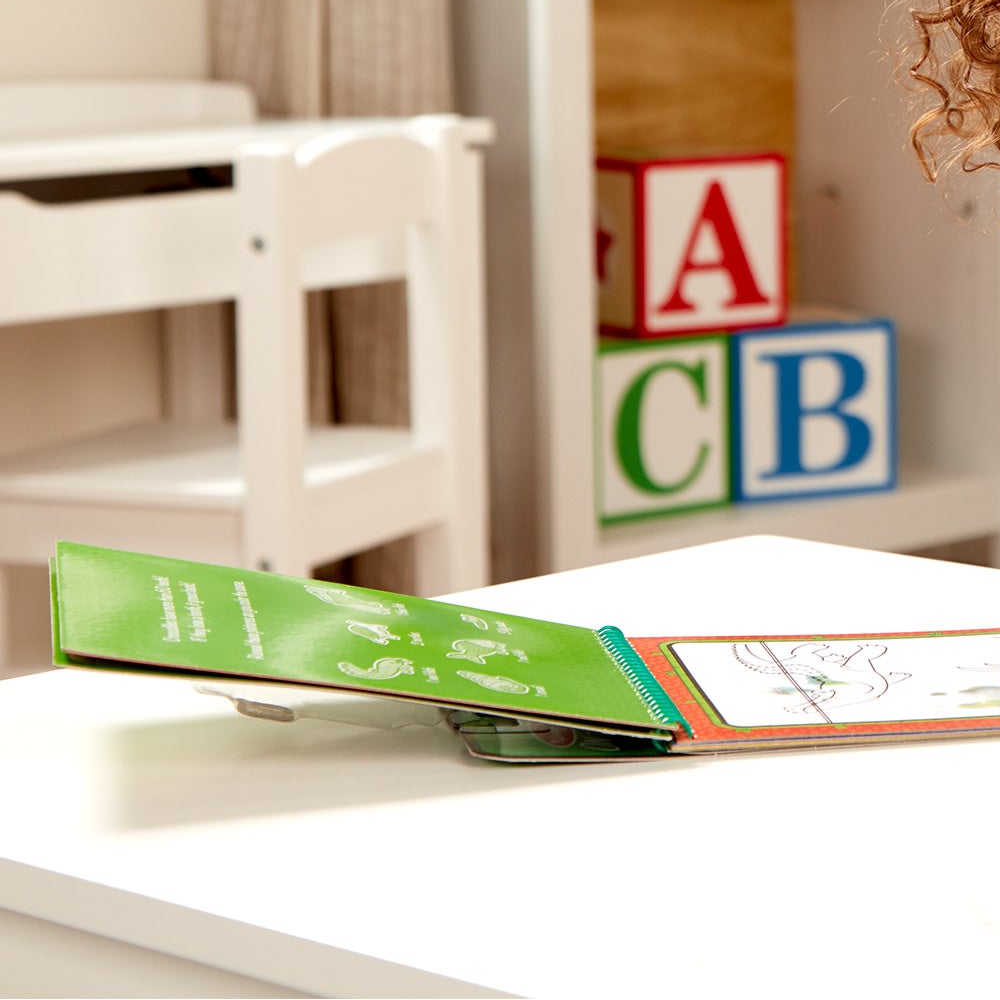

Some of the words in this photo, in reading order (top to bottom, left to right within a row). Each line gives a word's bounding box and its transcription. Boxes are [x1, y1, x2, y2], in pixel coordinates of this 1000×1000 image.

[656, 178, 771, 313] A
[613, 355, 709, 496] C
[756, 350, 873, 482] B
